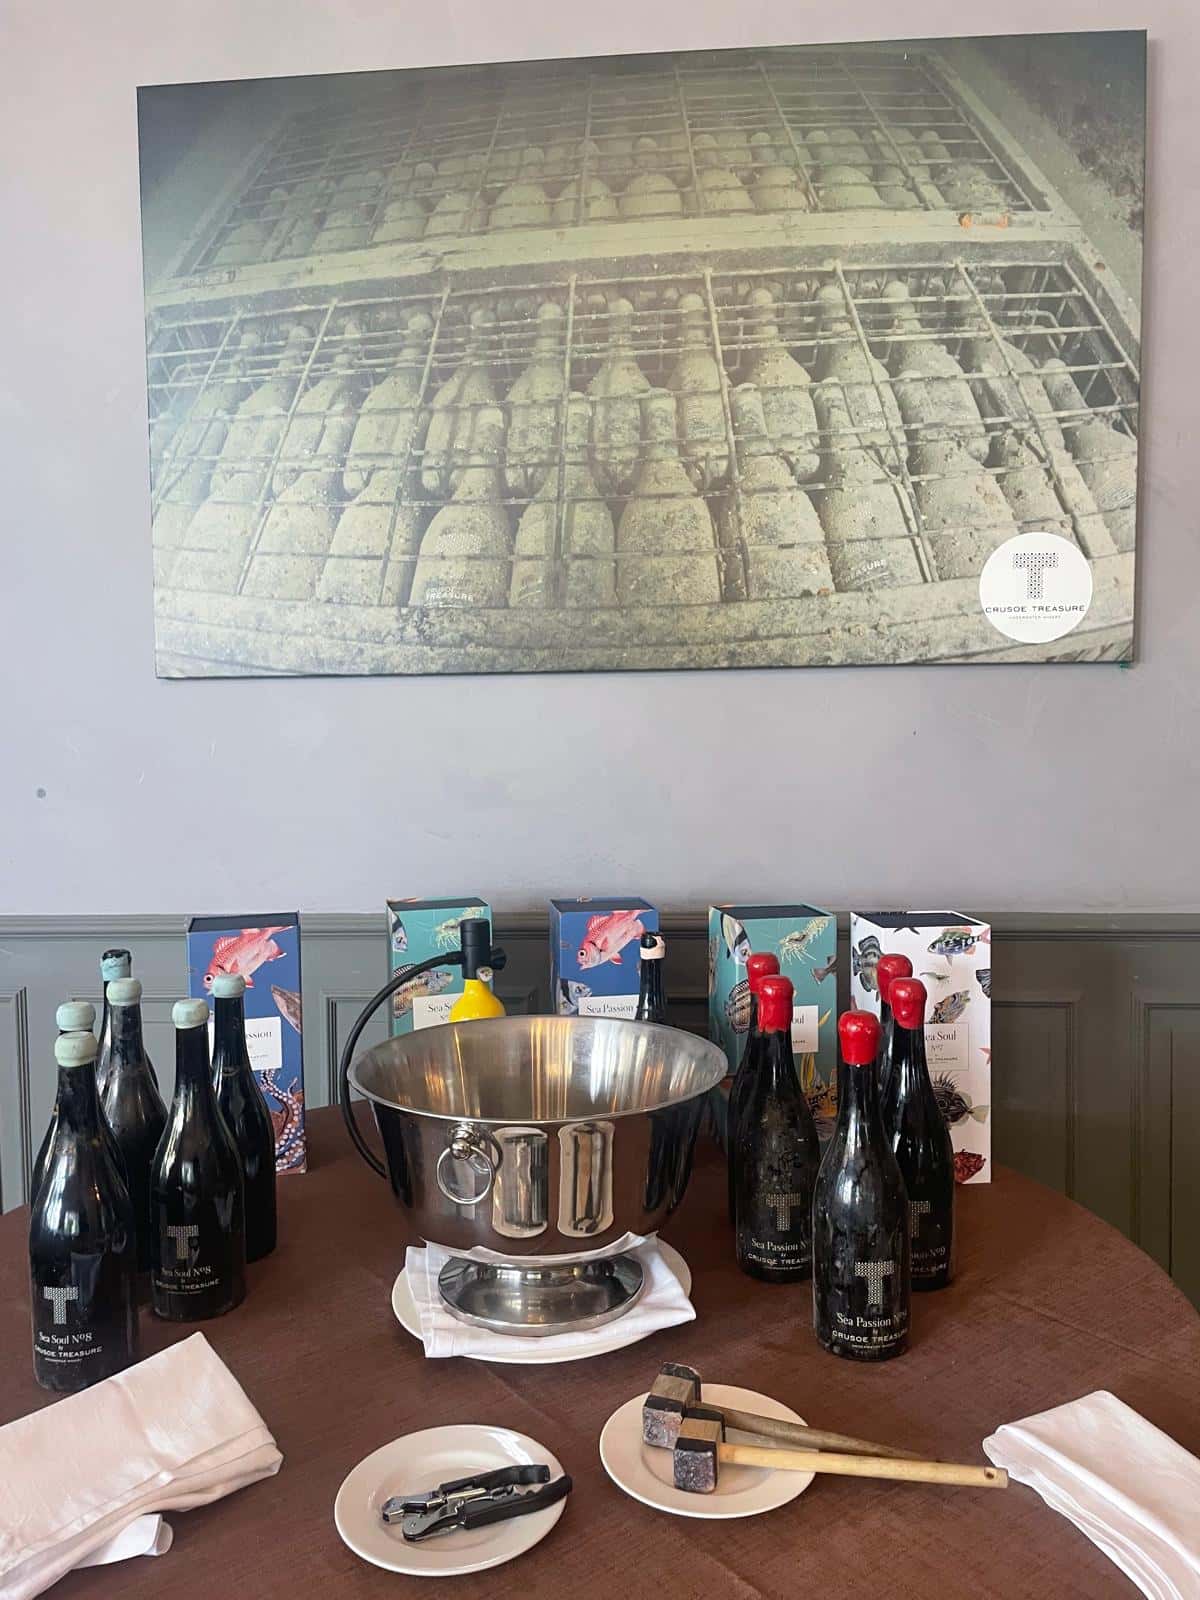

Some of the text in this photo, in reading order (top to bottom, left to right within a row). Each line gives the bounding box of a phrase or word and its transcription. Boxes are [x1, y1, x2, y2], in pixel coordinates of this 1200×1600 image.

[586, 1003, 634, 1014] Sea Passion
[937, 1029, 957, 1041] Soul
[752, 1237, 765, 1249] Sea
[767, 1241, 798, 1251] Passion
[836, 1312, 854, 1326] Sea
[856, 1316, 891, 1328] Passion
[51, 1334, 69, 1345] Soul
[832, 1329, 869, 1343] CRUSOE
[58, 1345, 102, 1358] TREASURE
